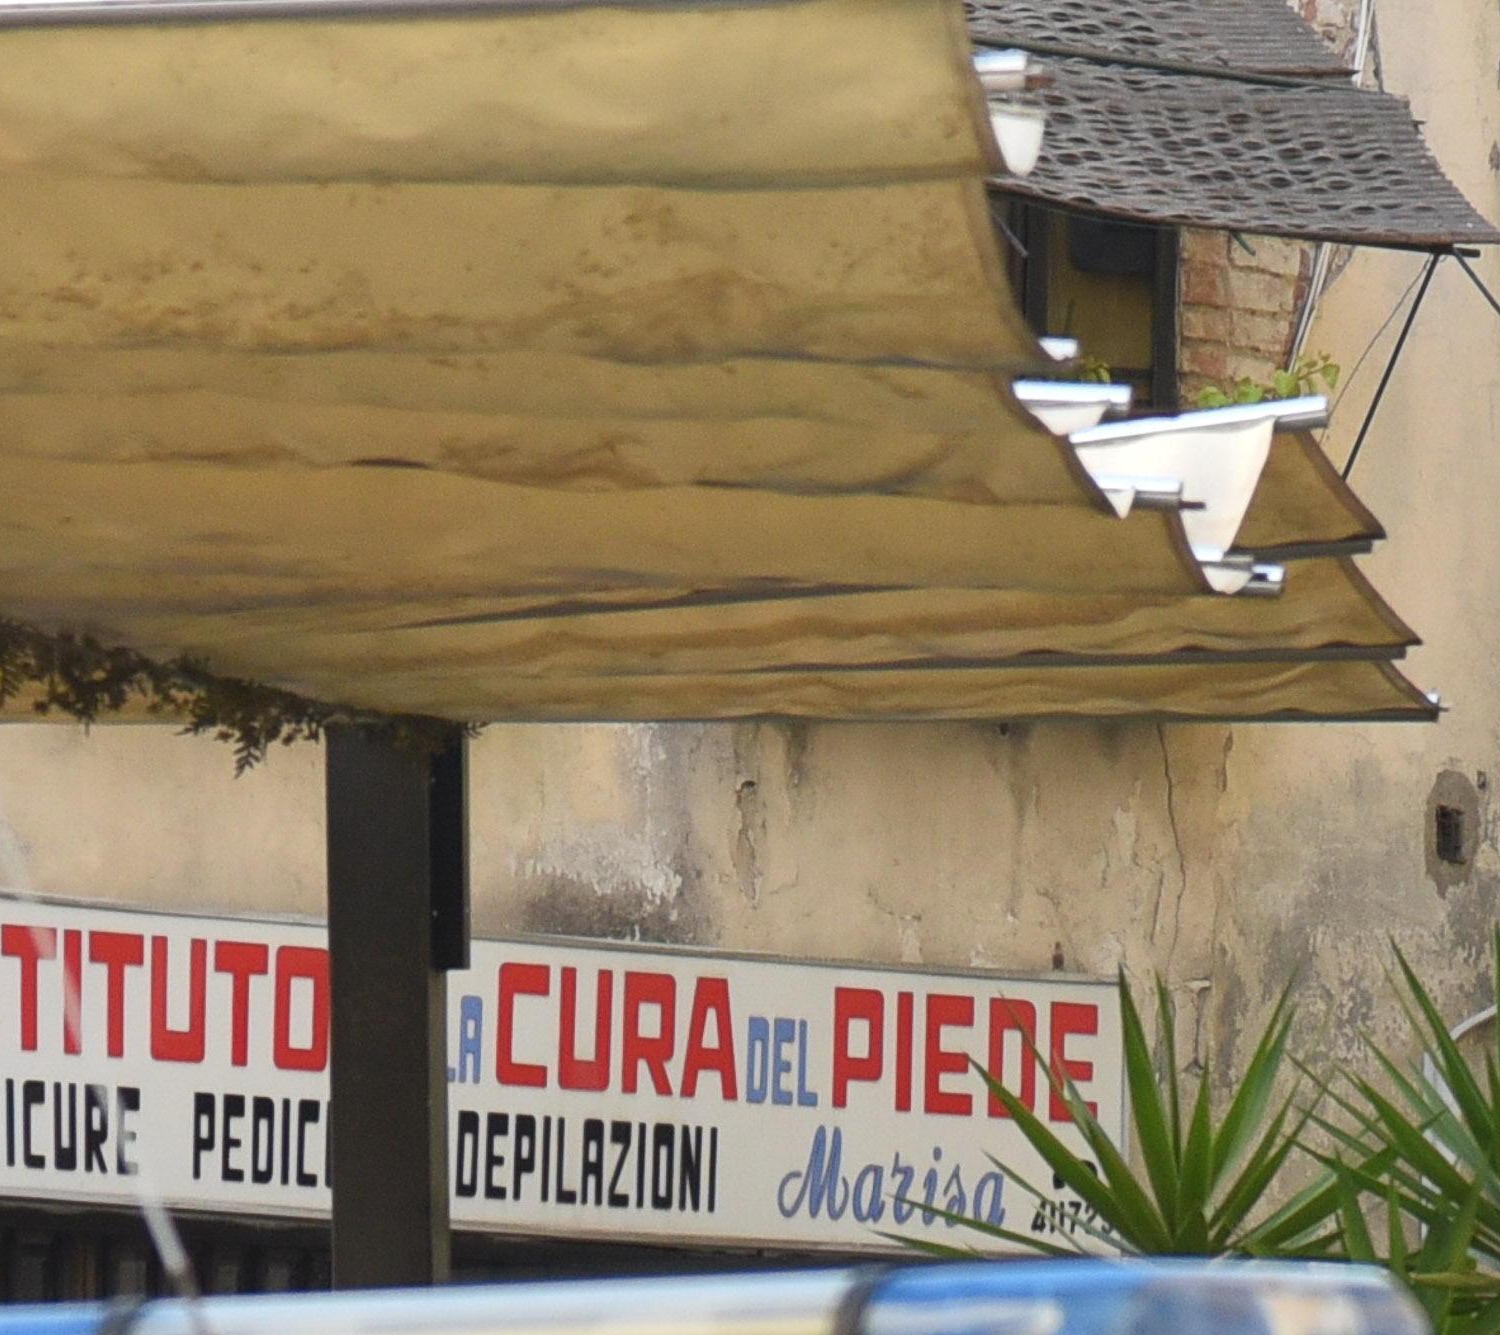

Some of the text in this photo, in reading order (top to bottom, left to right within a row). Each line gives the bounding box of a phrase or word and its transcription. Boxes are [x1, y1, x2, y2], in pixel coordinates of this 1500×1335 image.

[447, 995, 483, 1084] A
[496, 962, 738, 1101] CURA
[746, 1016, 818, 1107] DEL
[832, 986, 1098, 1122] PIEDE
[193, 1092, 332, 1188] PEDIC
[455, 1110, 718, 1213] DEPILAZIONI
[777, 1125, 1005, 1228] Marisa
